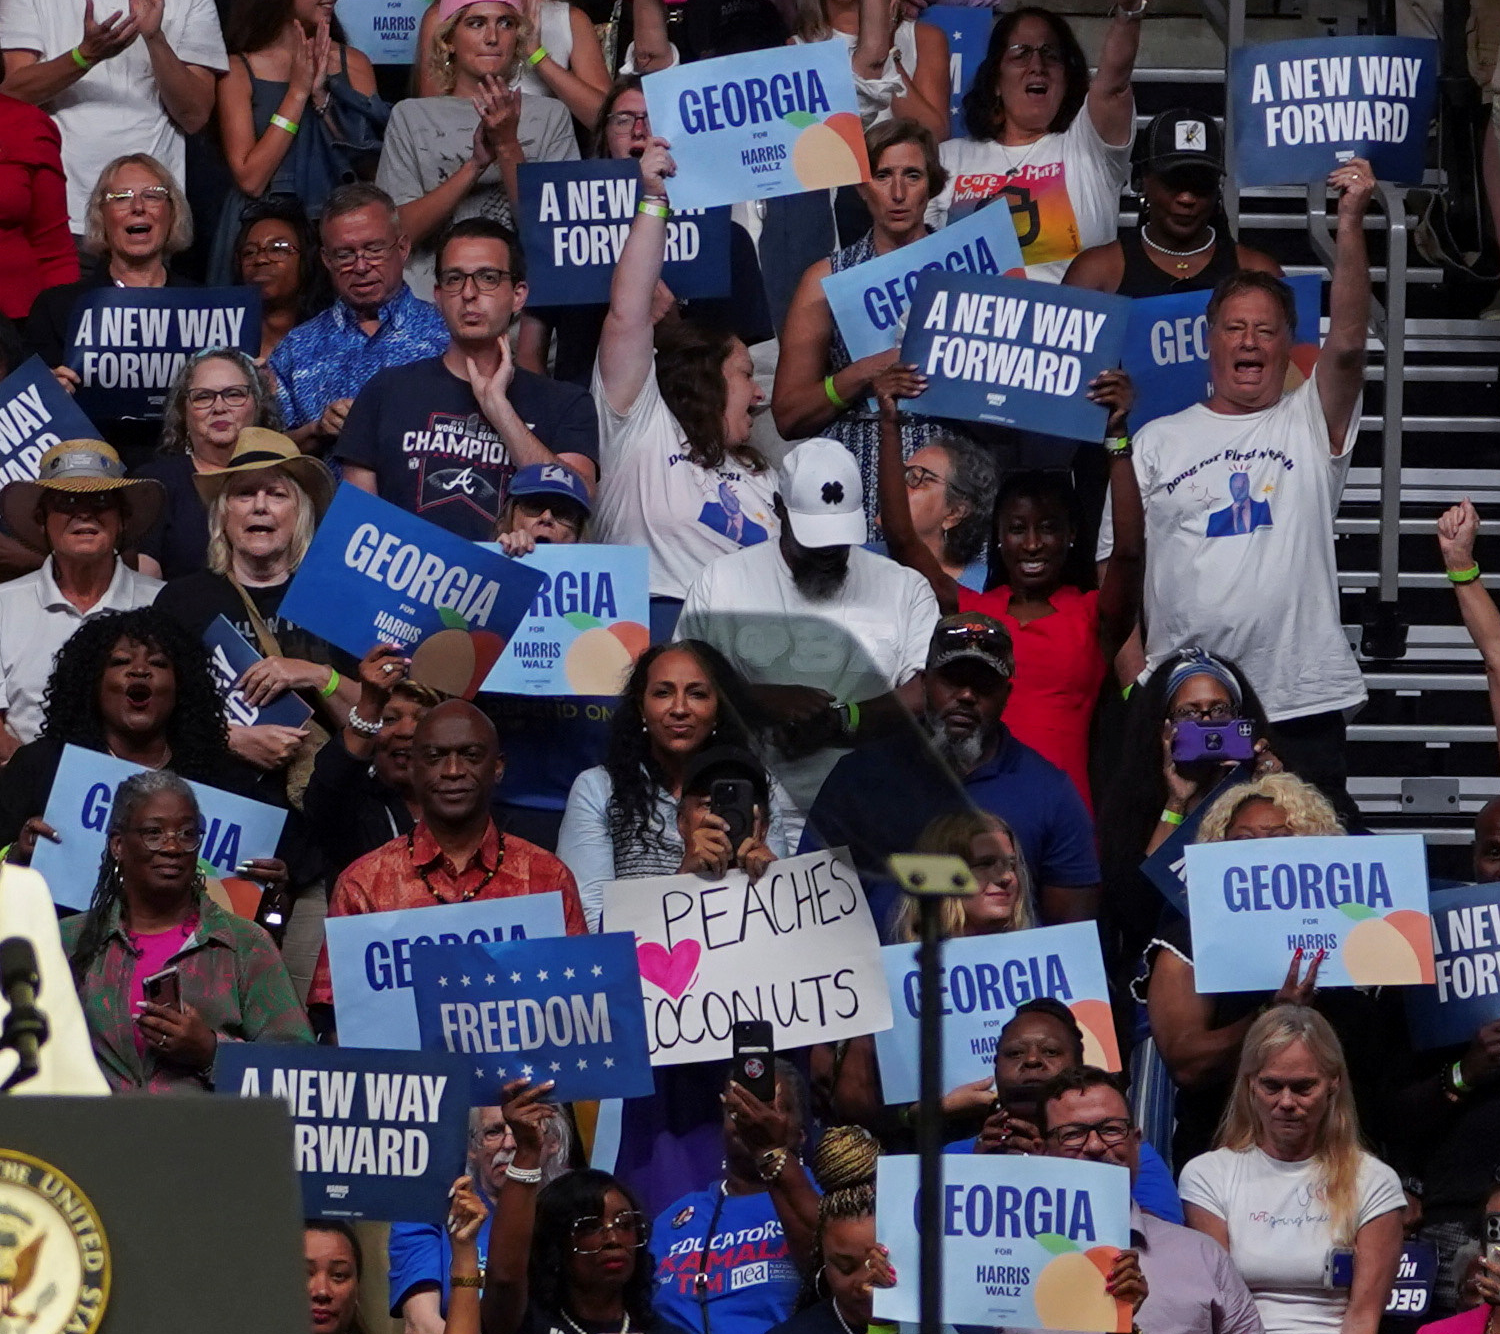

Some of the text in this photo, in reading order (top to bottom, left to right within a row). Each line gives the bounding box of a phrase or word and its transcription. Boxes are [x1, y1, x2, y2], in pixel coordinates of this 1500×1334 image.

[679, 70, 829, 133] GEORGIA
[740, 143, 787, 165] HARRIS
[925, 289, 1104, 352] A NEW WAY
[927, 340, 1081, 396] FORWARD
[1225, 448, 1257, 463] First
[664, 858, 857, 949] PEACHES
[1224, 861, 1392, 911] GEORGIA
[441, 992, 611, 1056] FREEDOM
[40, 1173, 104, 1271] UNITED
